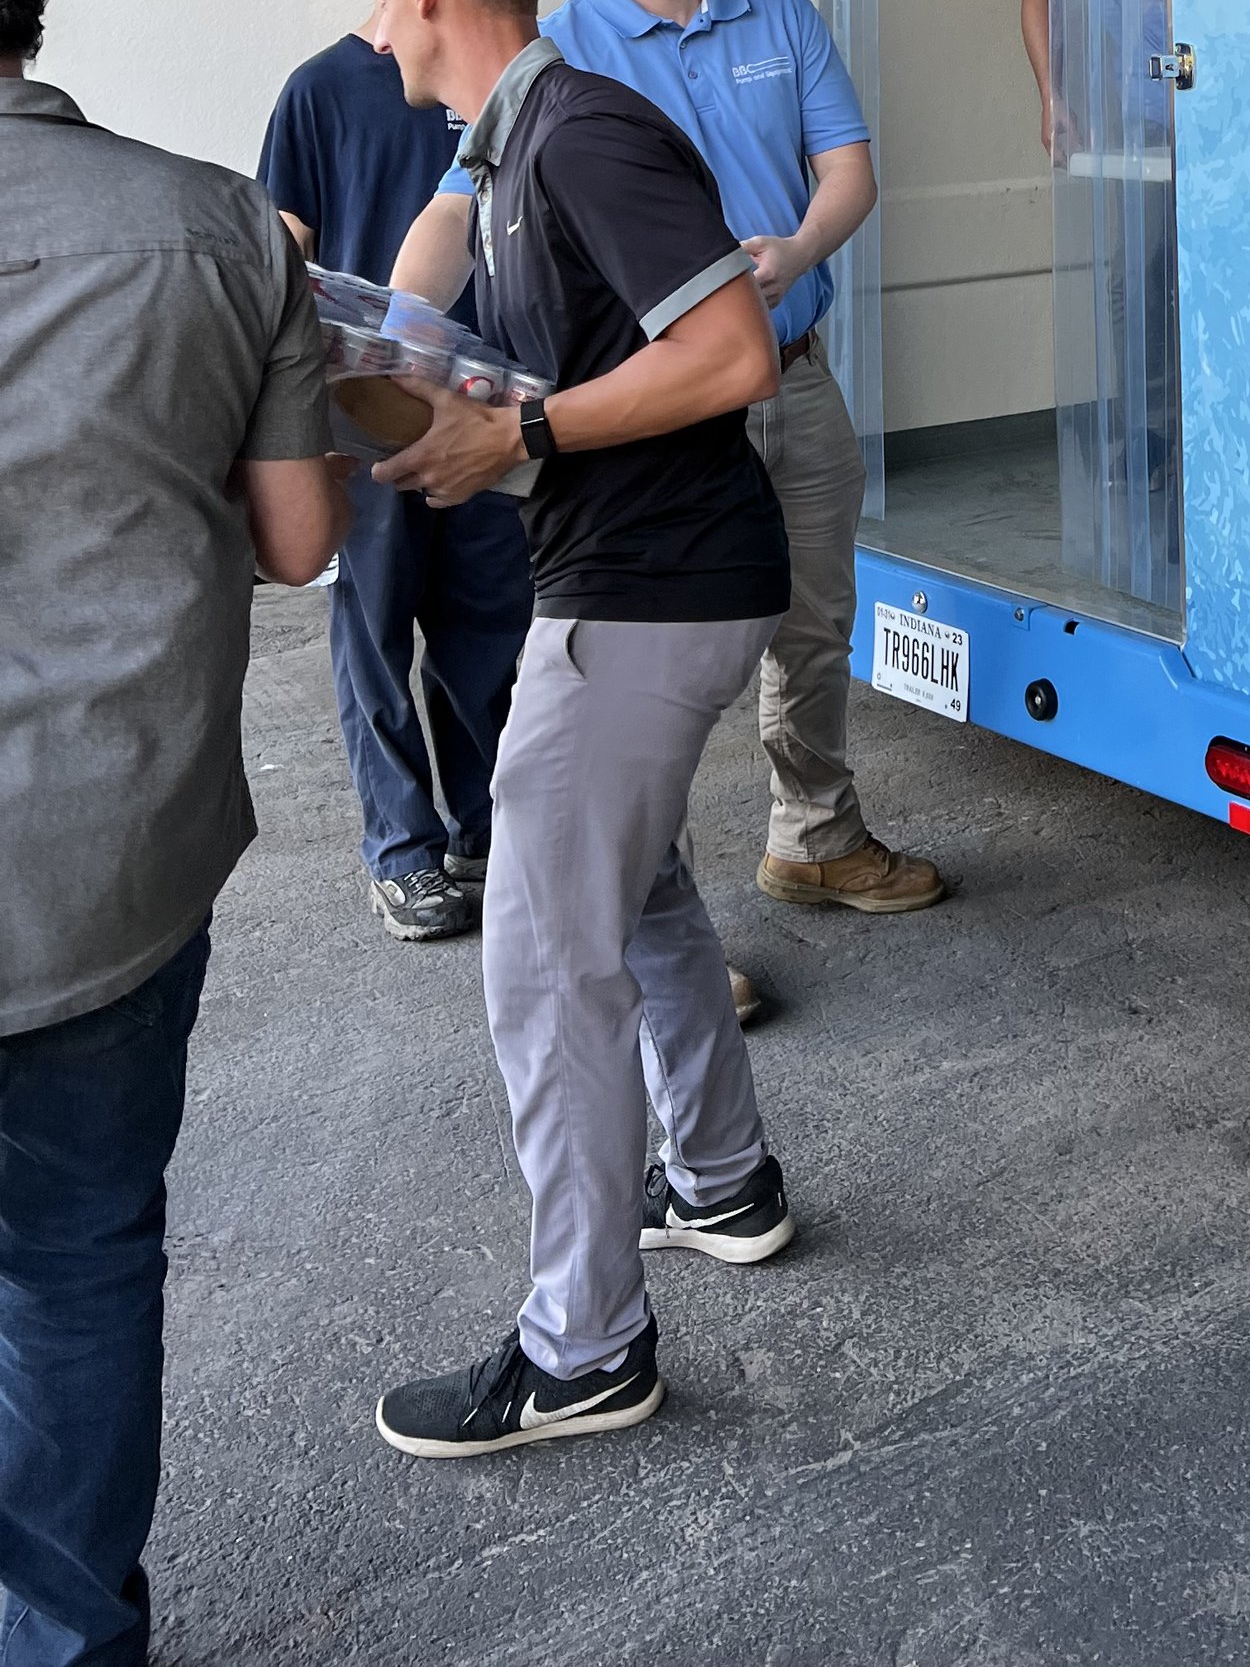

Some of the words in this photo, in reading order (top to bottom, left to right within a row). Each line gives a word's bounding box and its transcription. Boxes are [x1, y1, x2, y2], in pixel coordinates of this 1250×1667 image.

[900, 613, 941, 640] INDIANA
[952, 633, 963, 646] 23
[883, 628, 960, 692] TR966LHK
[950, 698, 961, 712] 49
